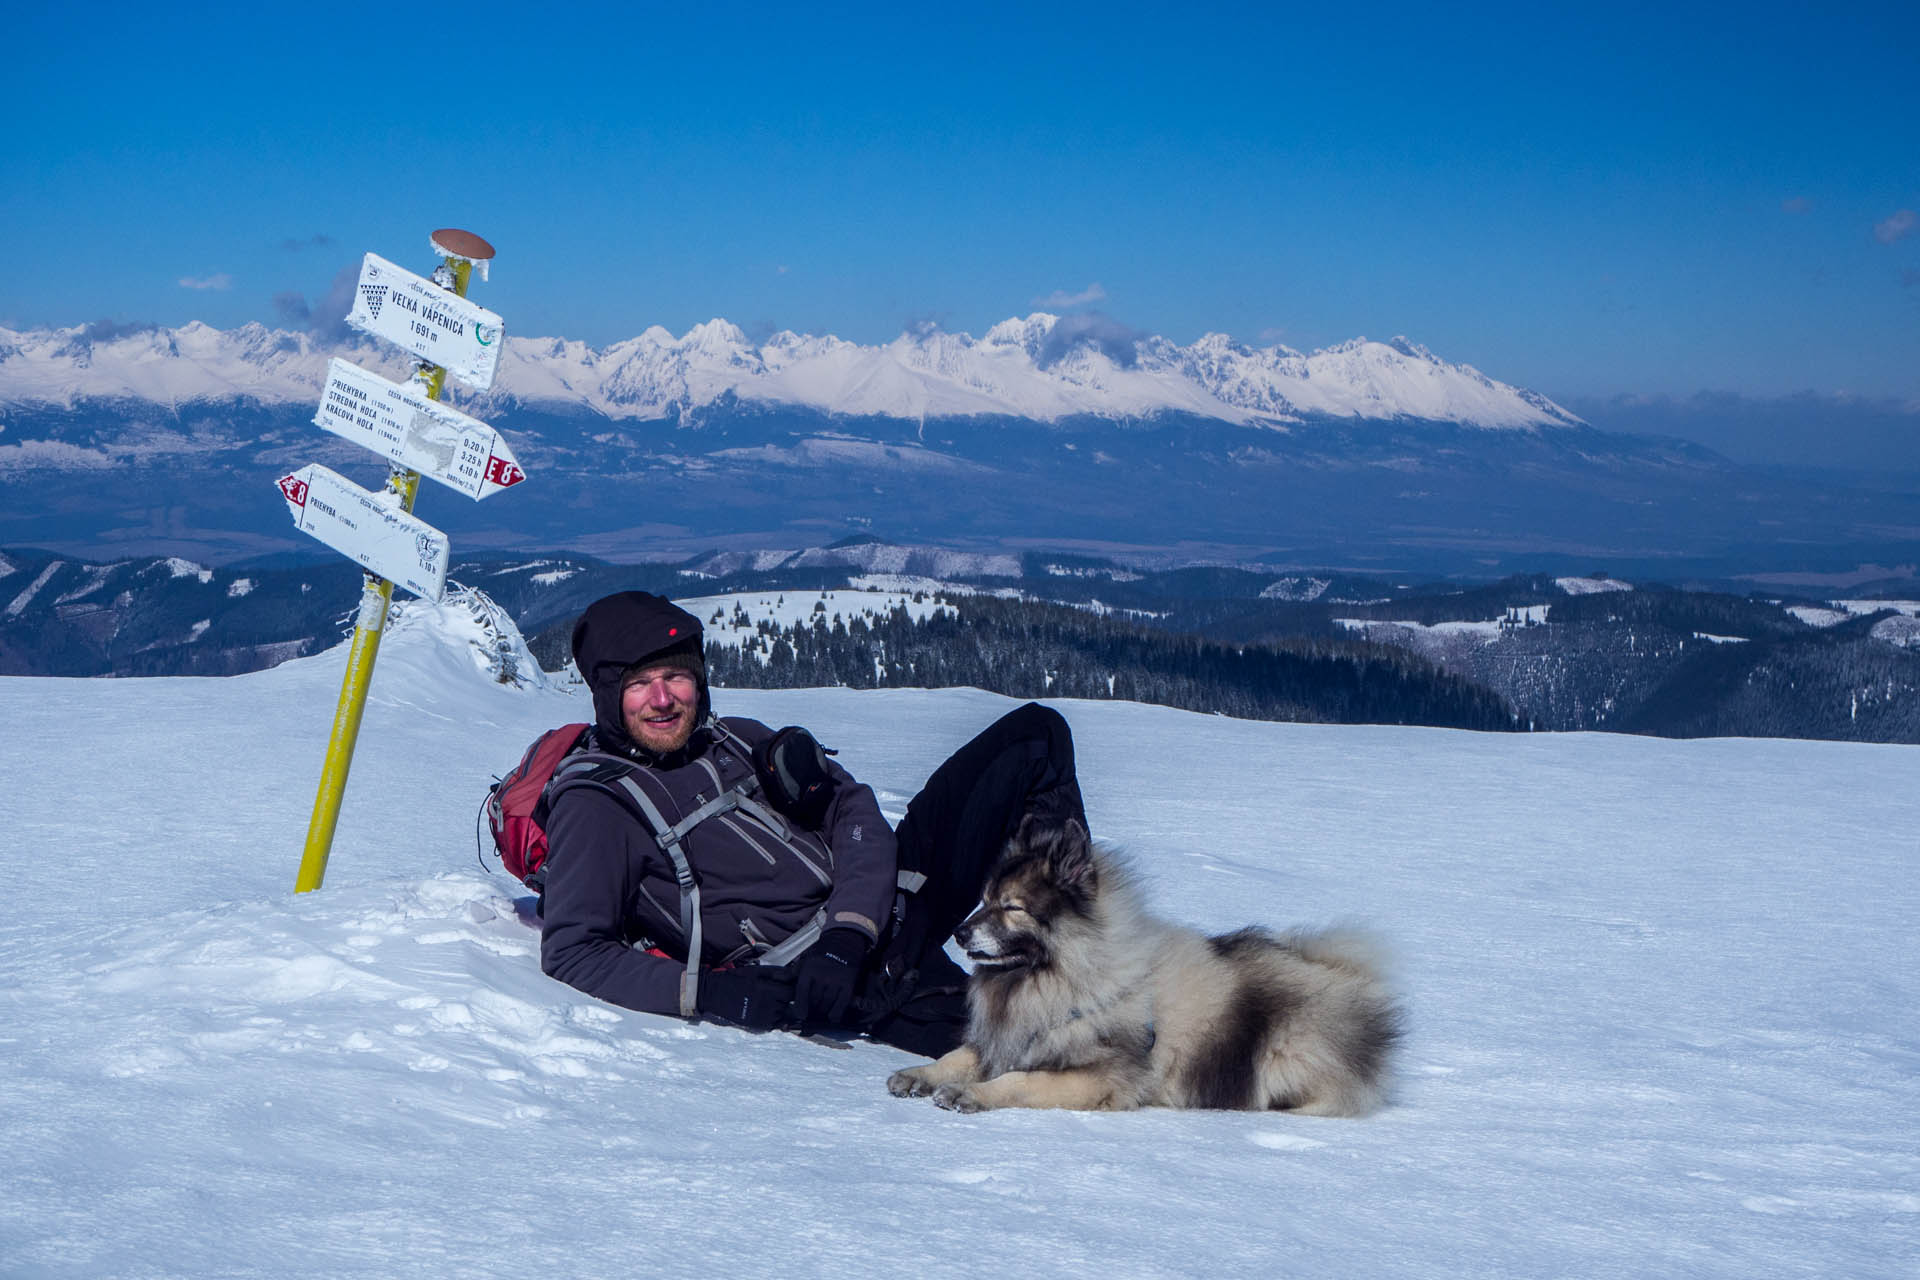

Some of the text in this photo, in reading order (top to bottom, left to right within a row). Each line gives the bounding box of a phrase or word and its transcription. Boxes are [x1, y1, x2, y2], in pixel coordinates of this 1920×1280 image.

[392, 290, 417, 314] VEĽKÁ
[422, 304, 464, 337] VÁPENICA
[430, 332, 438, 343] m
[464, 438, 486, 455] 0:20 h
[461, 450, 482, 468] 3:25 h
[458, 464, 479, 480] 4:10 h
[310, 496, 336, 518] PRIEHYBA
